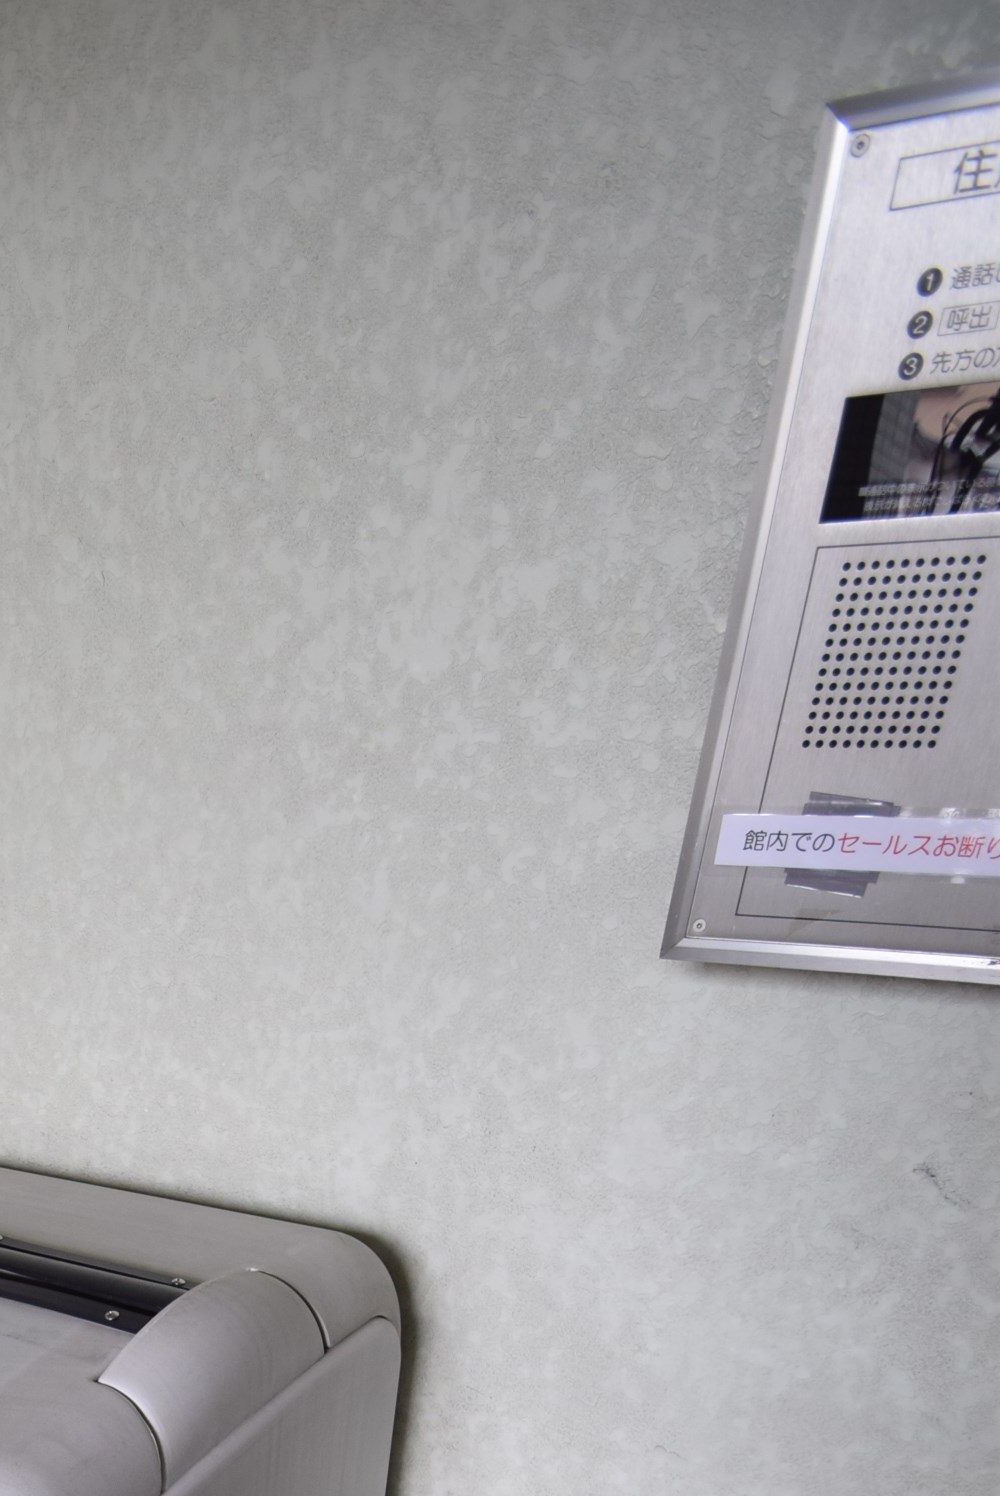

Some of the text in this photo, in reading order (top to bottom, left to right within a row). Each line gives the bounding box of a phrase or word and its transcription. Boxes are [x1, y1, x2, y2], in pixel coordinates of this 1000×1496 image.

[953, 149, 1000, 195] 住
[950, 261, 1000, 289] 通話
[946, 305, 992, 332] 呼出
[929, 347, 1000, 375] 先方の
